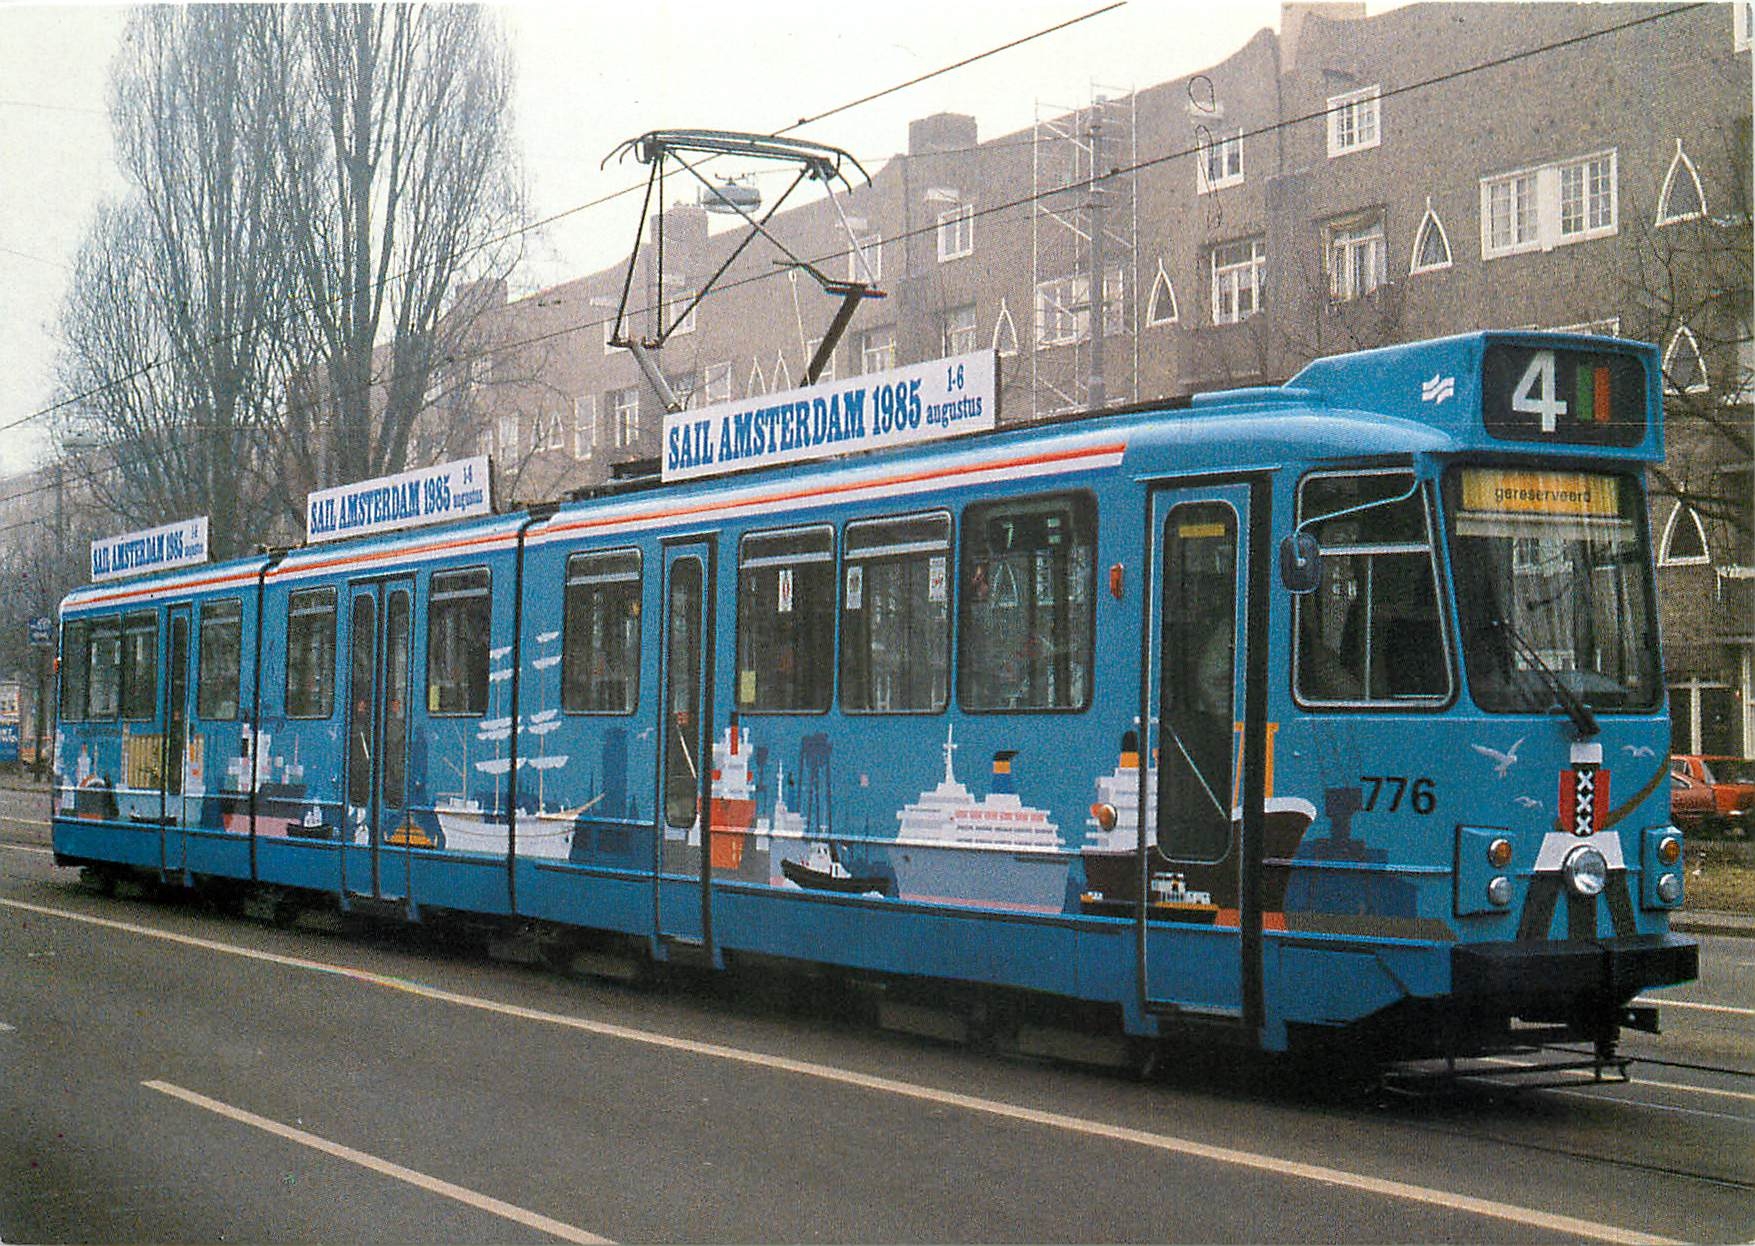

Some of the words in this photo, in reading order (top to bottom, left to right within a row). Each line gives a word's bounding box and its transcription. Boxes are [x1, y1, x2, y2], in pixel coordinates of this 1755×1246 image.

[946, 364, 965, 392] 1-6
[1512, 350, 1568, 432] 4
[668, 419, 714, 470] SAIL
[718, 388, 867, 462] AMSTERDAM
[872, 378, 922, 436] 1985
[926, 395, 983, 428] augustus
[310, 498, 337, 534] SAIL
[338, 479, 421, 529] AMSTERDAM
[423, 473, 451, 515] 1985
[1494, 487, 1592, 501] gereserveerd
[1360, 776, 1437, 815] 776
